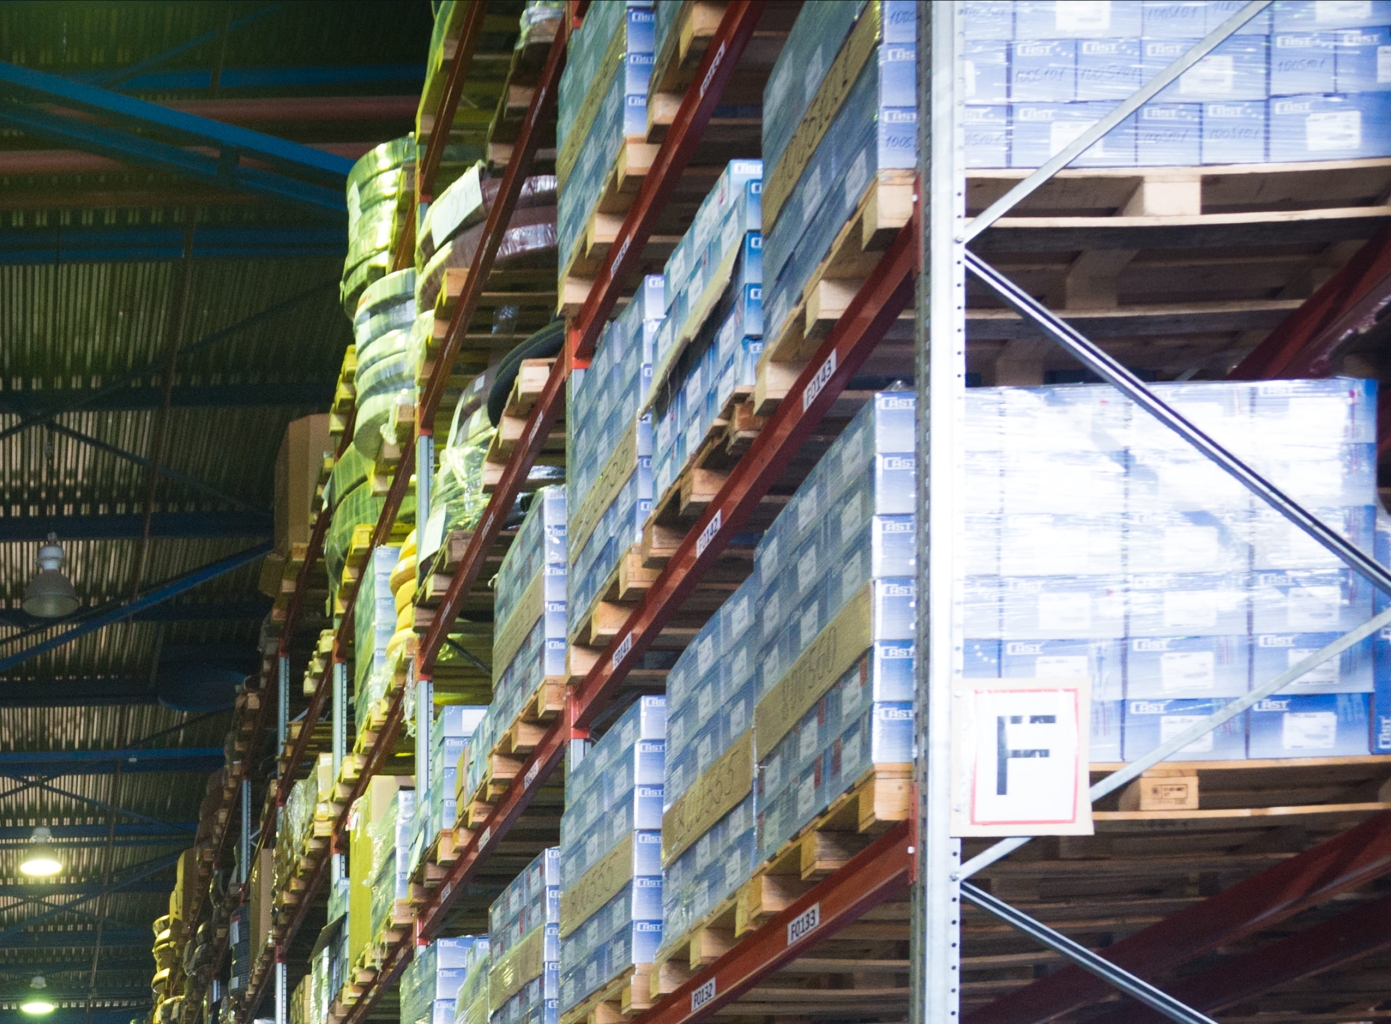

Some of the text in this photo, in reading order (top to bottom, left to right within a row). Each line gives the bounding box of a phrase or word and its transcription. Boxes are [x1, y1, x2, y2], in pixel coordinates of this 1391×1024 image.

[1017, 43, 1053, 56] CAST
[1082, 42, 1118, 54] CAST
[1147, 44, 1181, 56] CAST
[1019, 108, 1055, 120] CAST
[1209, 105, 1243, 117] CAST
[1275, 102, 1311, 114] CAST
[806, 359, 832, 406] F0143
[1134, 639, 1168, 652] CAST
[1259, 635, 1294, 647] CAST
[1007, 642, 1043, 655] CAST
[1131, 702, 1166, 714] CAST
[1254, 699, 1290, 711] CAST
[996, 714, 1057, 796] F
[637, 923, 662, 932] CAST
[790, 909, 816, 938] F0133
[693, 982, 714, 1008] F0132
